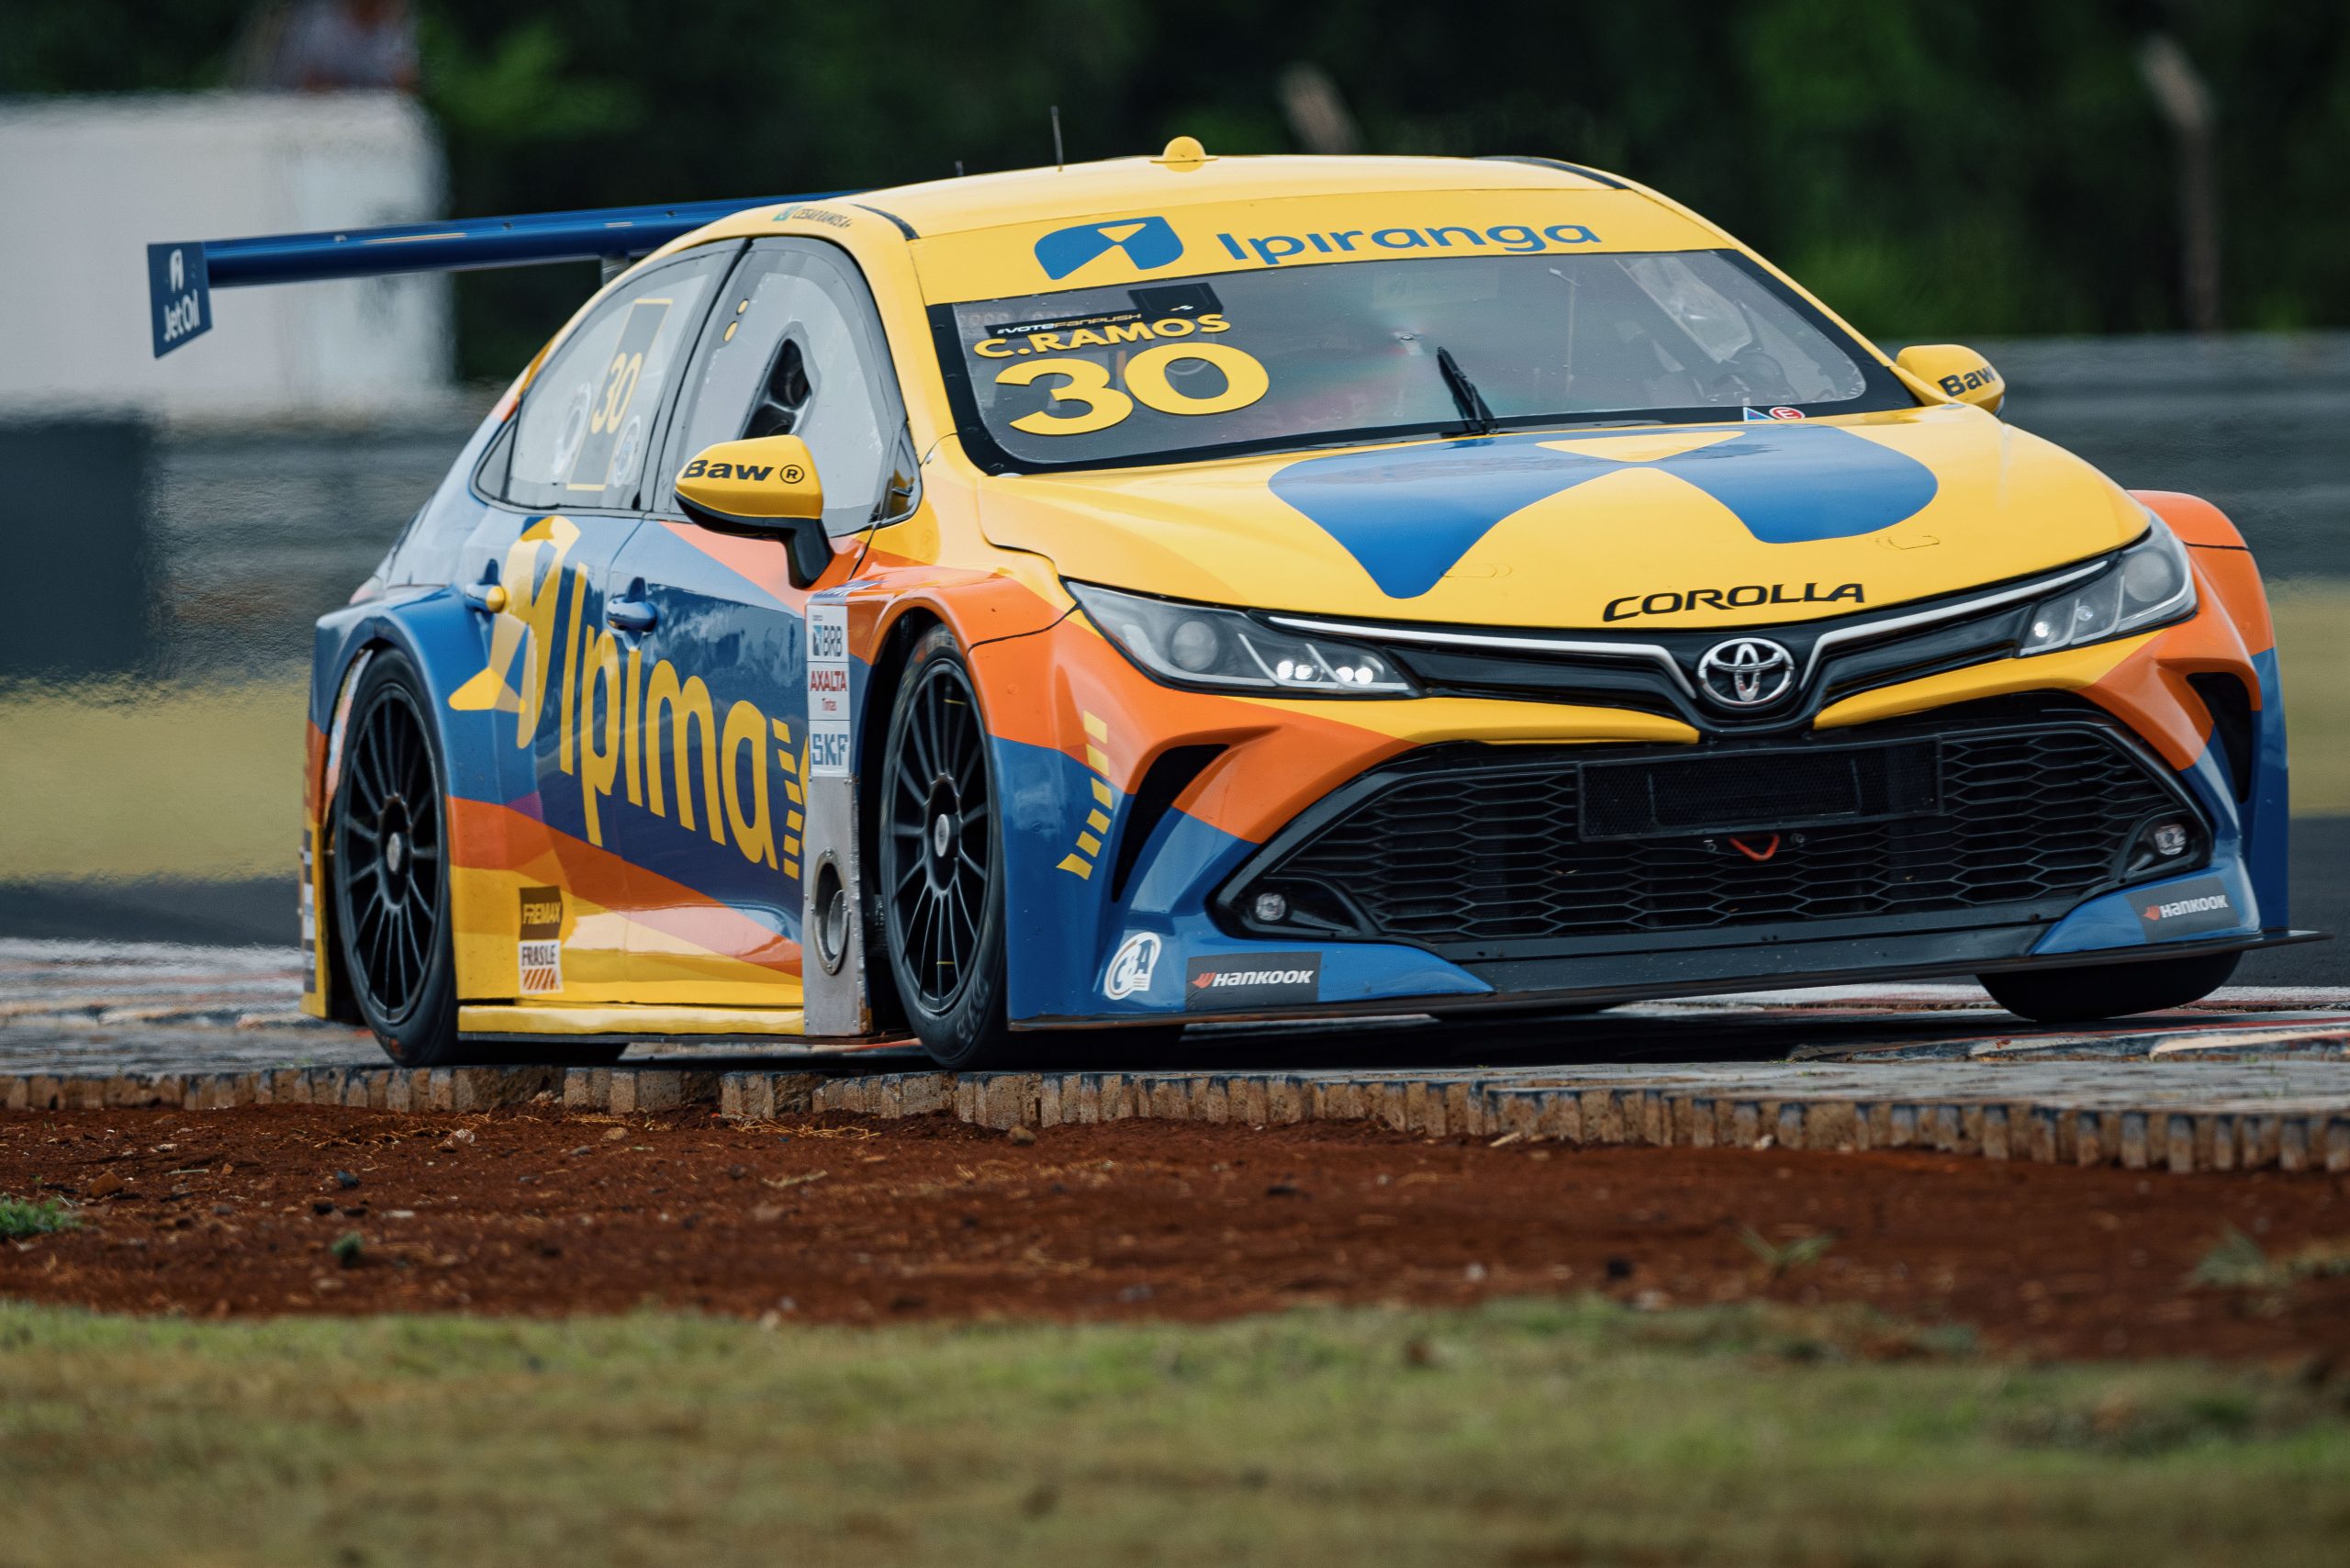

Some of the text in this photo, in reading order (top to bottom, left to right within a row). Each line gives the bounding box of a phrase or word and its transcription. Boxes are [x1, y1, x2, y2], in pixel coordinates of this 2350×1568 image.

[1217, 225, 1602, 265] Ipiranga
[974, 314, 1231, 358] C.RAMOS
[591, 353, 642, 434] 30
[995, 342, 1270, 435] 30
[1938, 366, 1996, 397] Baw
[1602, 582, 1865, 622] COROLLA
[823, 625, 843, 657] BRB
[810, 670, 847, 692] AXALTA
[812, 734, 848, 766] SKF
